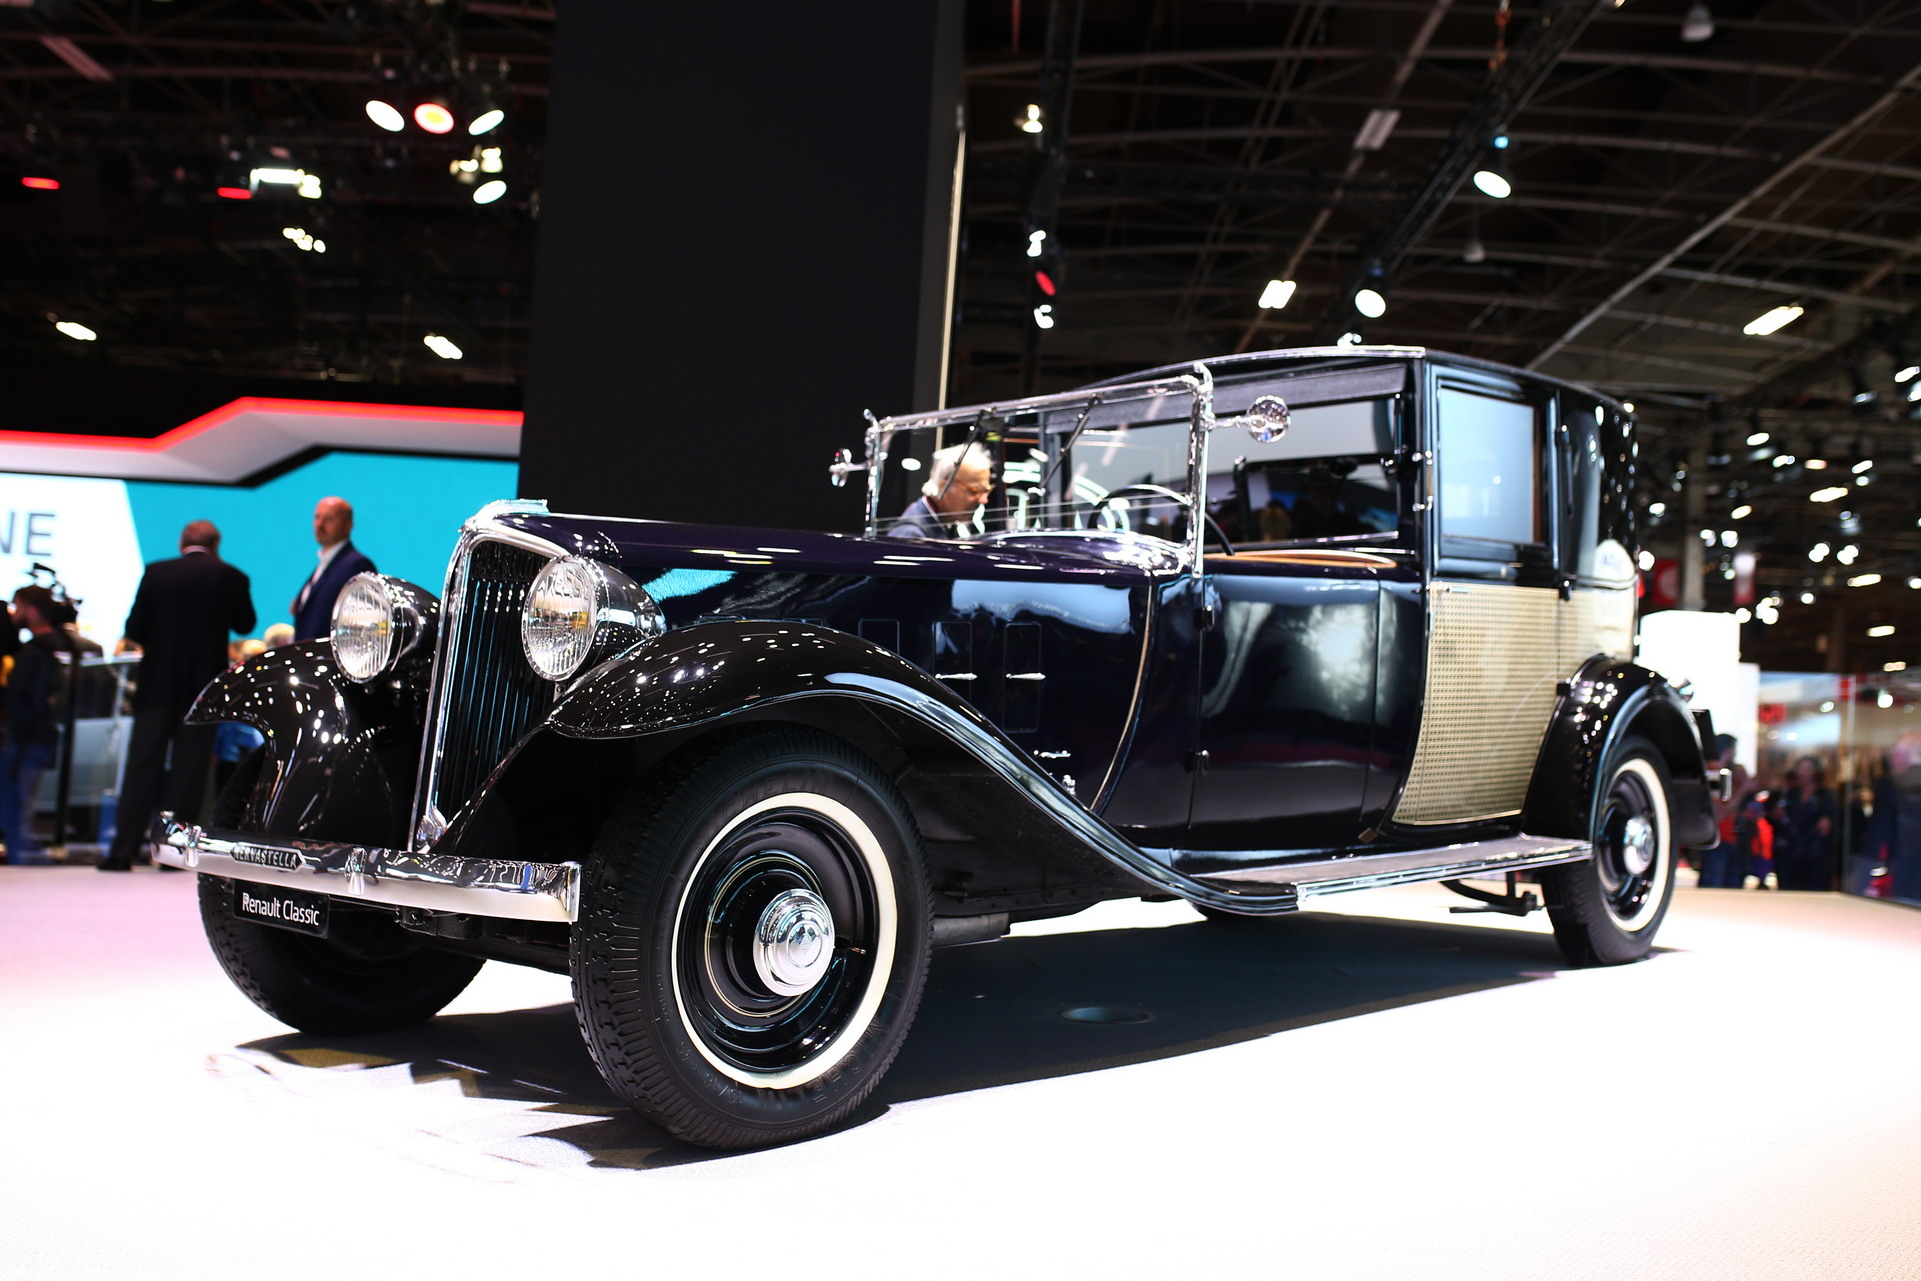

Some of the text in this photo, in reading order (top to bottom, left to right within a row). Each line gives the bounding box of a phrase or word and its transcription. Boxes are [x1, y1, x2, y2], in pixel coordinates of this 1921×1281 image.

[692, 772, 832, 857] MICHELIN
[233, 846, 297, 869] NERVASTELLA
[242, 892, 320, 926] Renault Classic
[756, 1017, 889, 1113] MICHELIN
